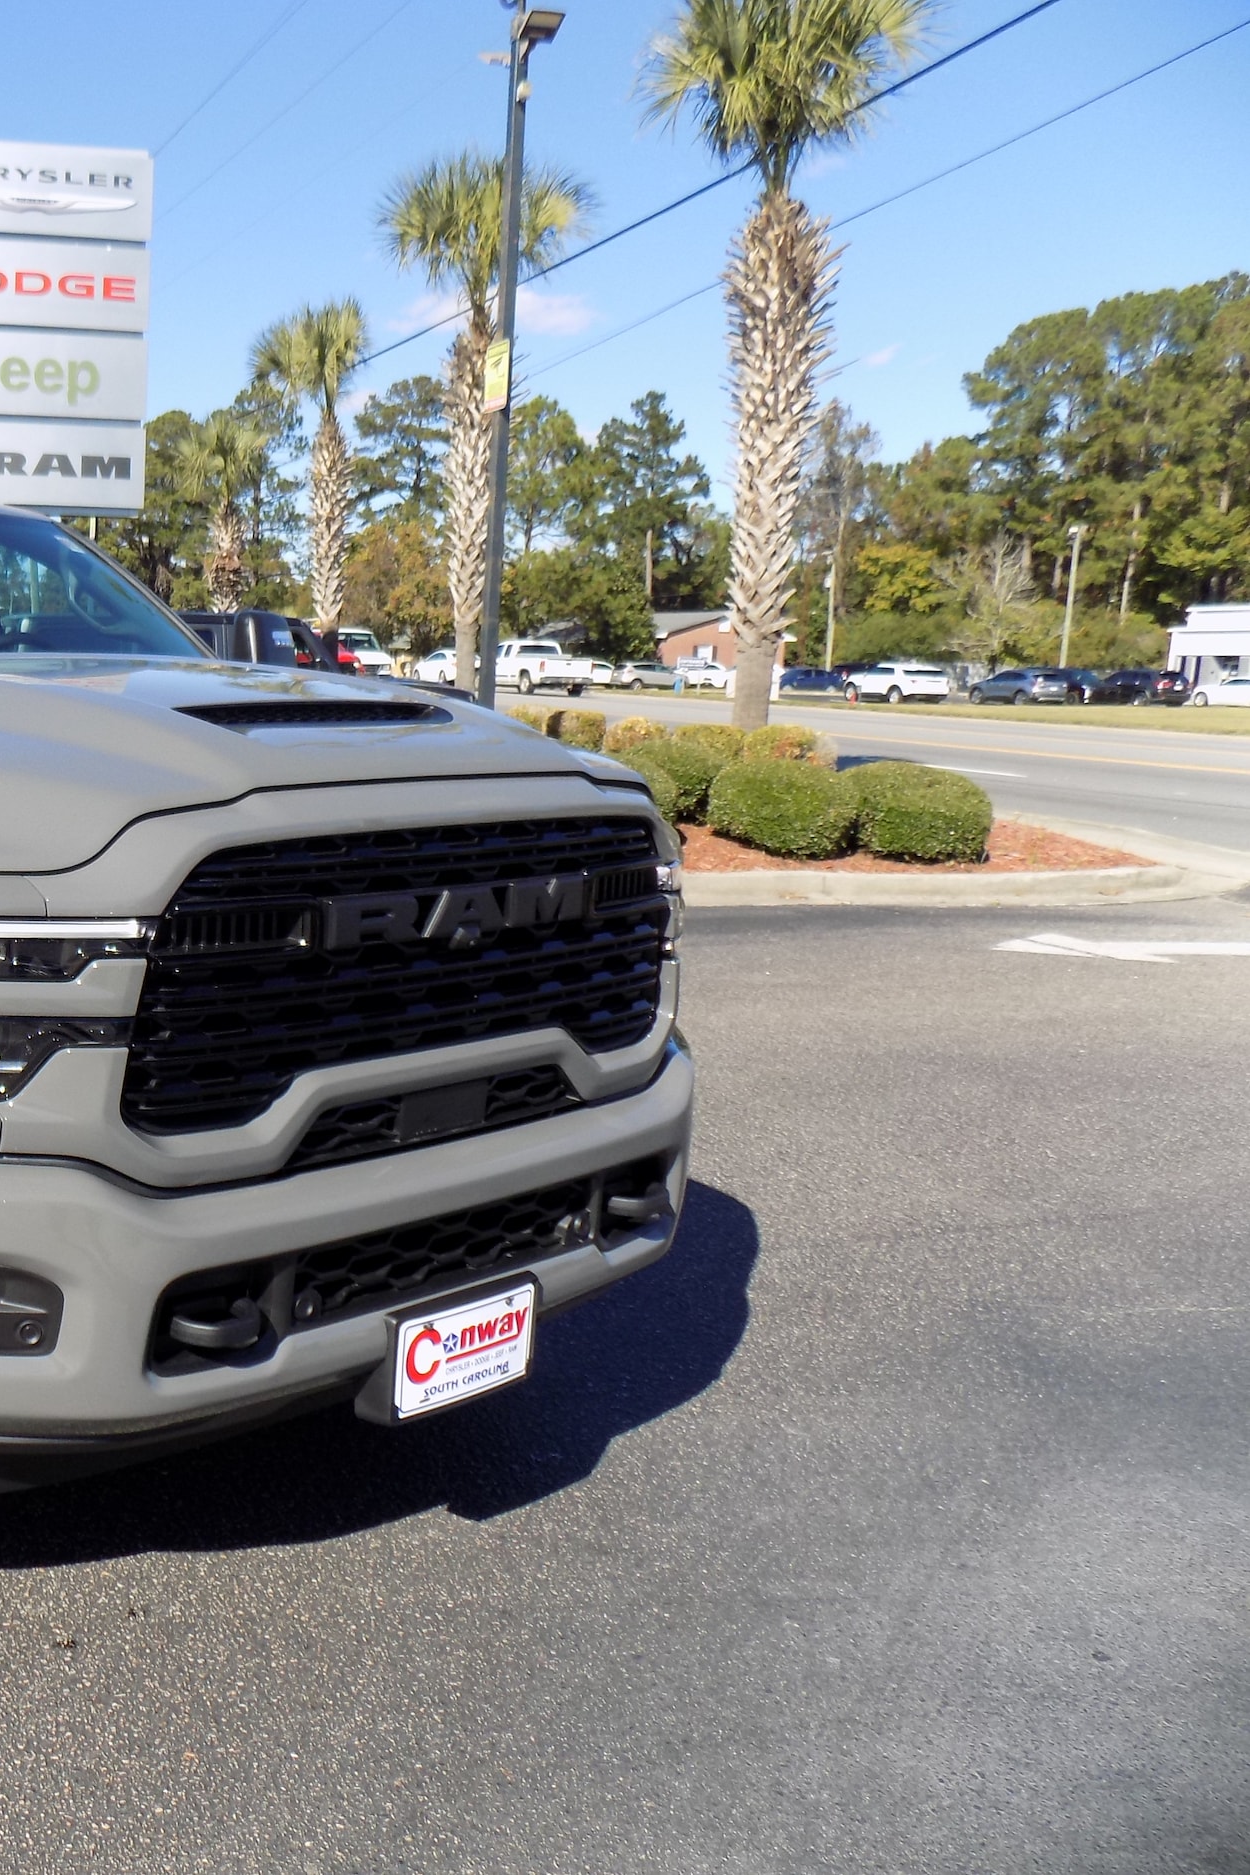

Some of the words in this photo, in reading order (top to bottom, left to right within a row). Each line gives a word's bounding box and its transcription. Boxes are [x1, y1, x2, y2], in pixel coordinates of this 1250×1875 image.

[324, 872, 584, 949] RAM
[423, 1379, 459, 1398] SOUTH
[462, 1361, 510, 1385] CAROLINA
